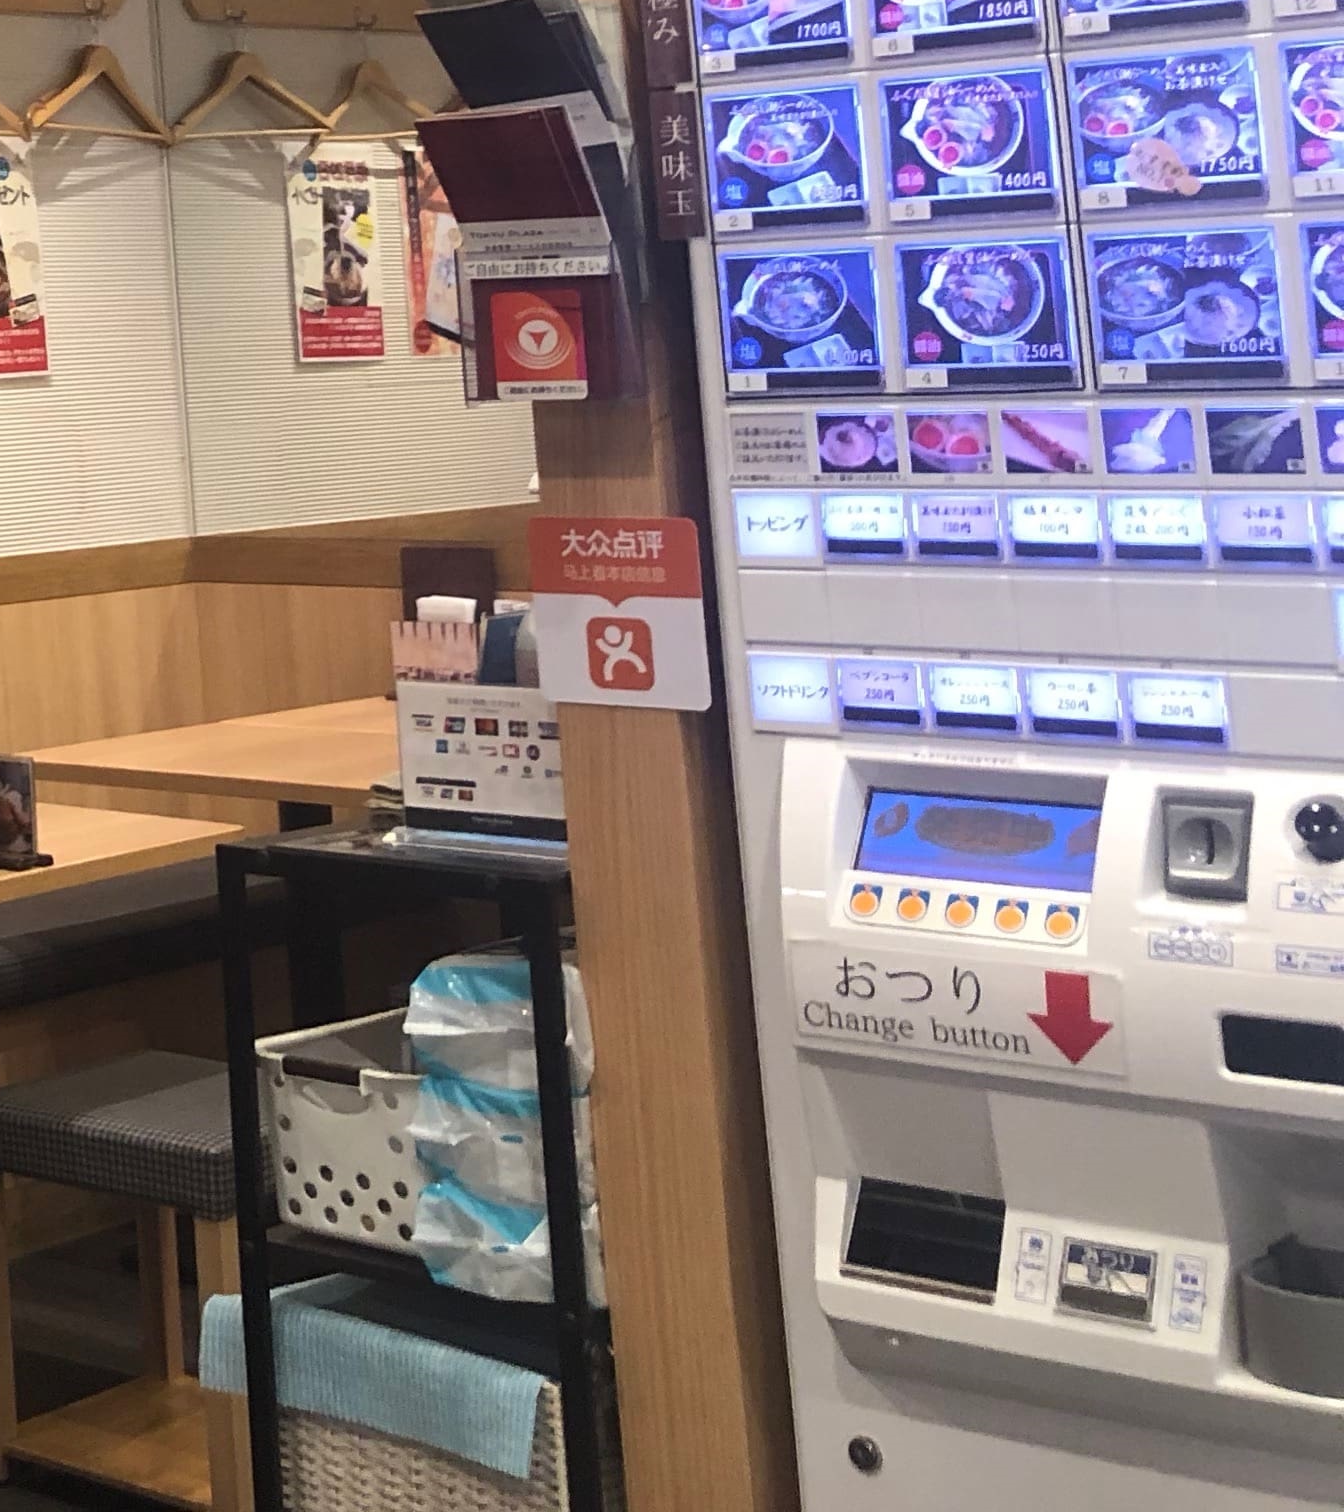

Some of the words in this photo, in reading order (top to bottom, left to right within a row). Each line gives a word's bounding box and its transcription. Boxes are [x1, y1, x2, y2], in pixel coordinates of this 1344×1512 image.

[979, 0, 1028, 19] 1850円
[797, 21, 841, 39] 1700円
[661, 116, 697, 218] 美味玉
[1200, 155, 1255, 173] 1750円
[1316, 177, 1334, 192] 11
[905, 205, 915, 217] 5
[728, 216, 738, 227] 2
[1221, 337, 1275, 354] 1600円
[1118, 368, 1128, 380] 7
[747, 515, 809, 533] トッピング
[561, 530, 664, 558] 大众点评
[756, 682, 830, 700] ソフトドリンク
[835, 956, 981, 1015] おつり
[803, 999, 914, 1043] Change
[931, 1015, 1032, 1057] button
